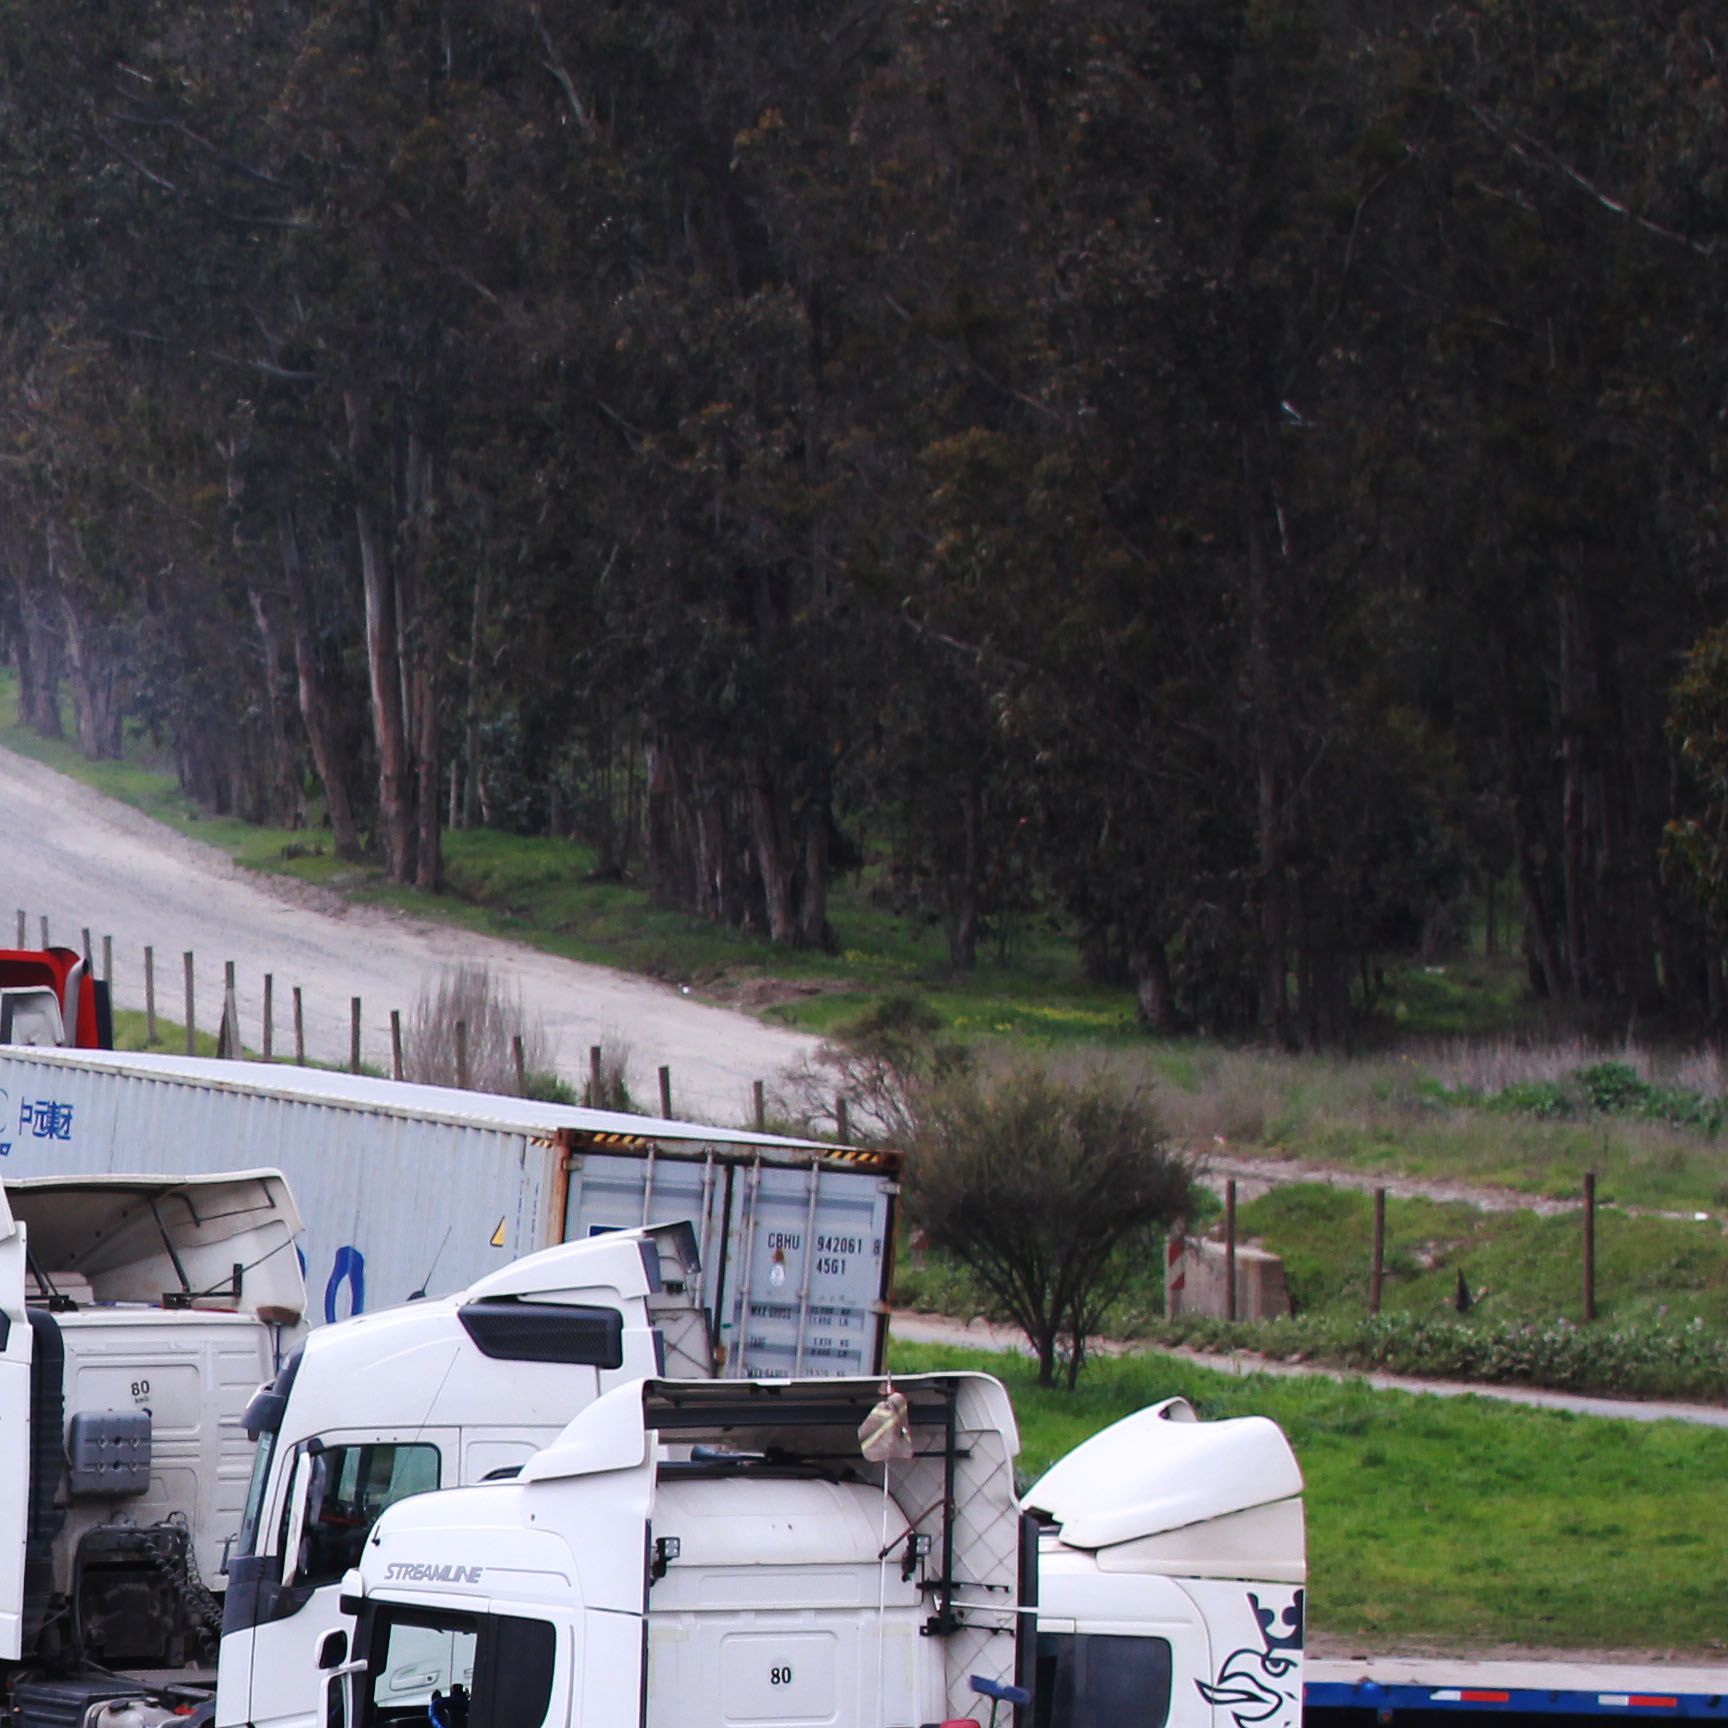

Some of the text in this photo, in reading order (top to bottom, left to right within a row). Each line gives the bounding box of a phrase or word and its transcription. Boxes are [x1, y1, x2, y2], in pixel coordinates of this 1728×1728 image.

[767, 1231, 801, 1250] CBHU
[817, 1235, 864, 1255] 942061
[816, 1257, 846, 1276] 45G1
[131, 1380, 150, 1397] 80
[384, 1562, 484, 1584] STREAMLINE
[771, 1667, 792, 1685] 80
